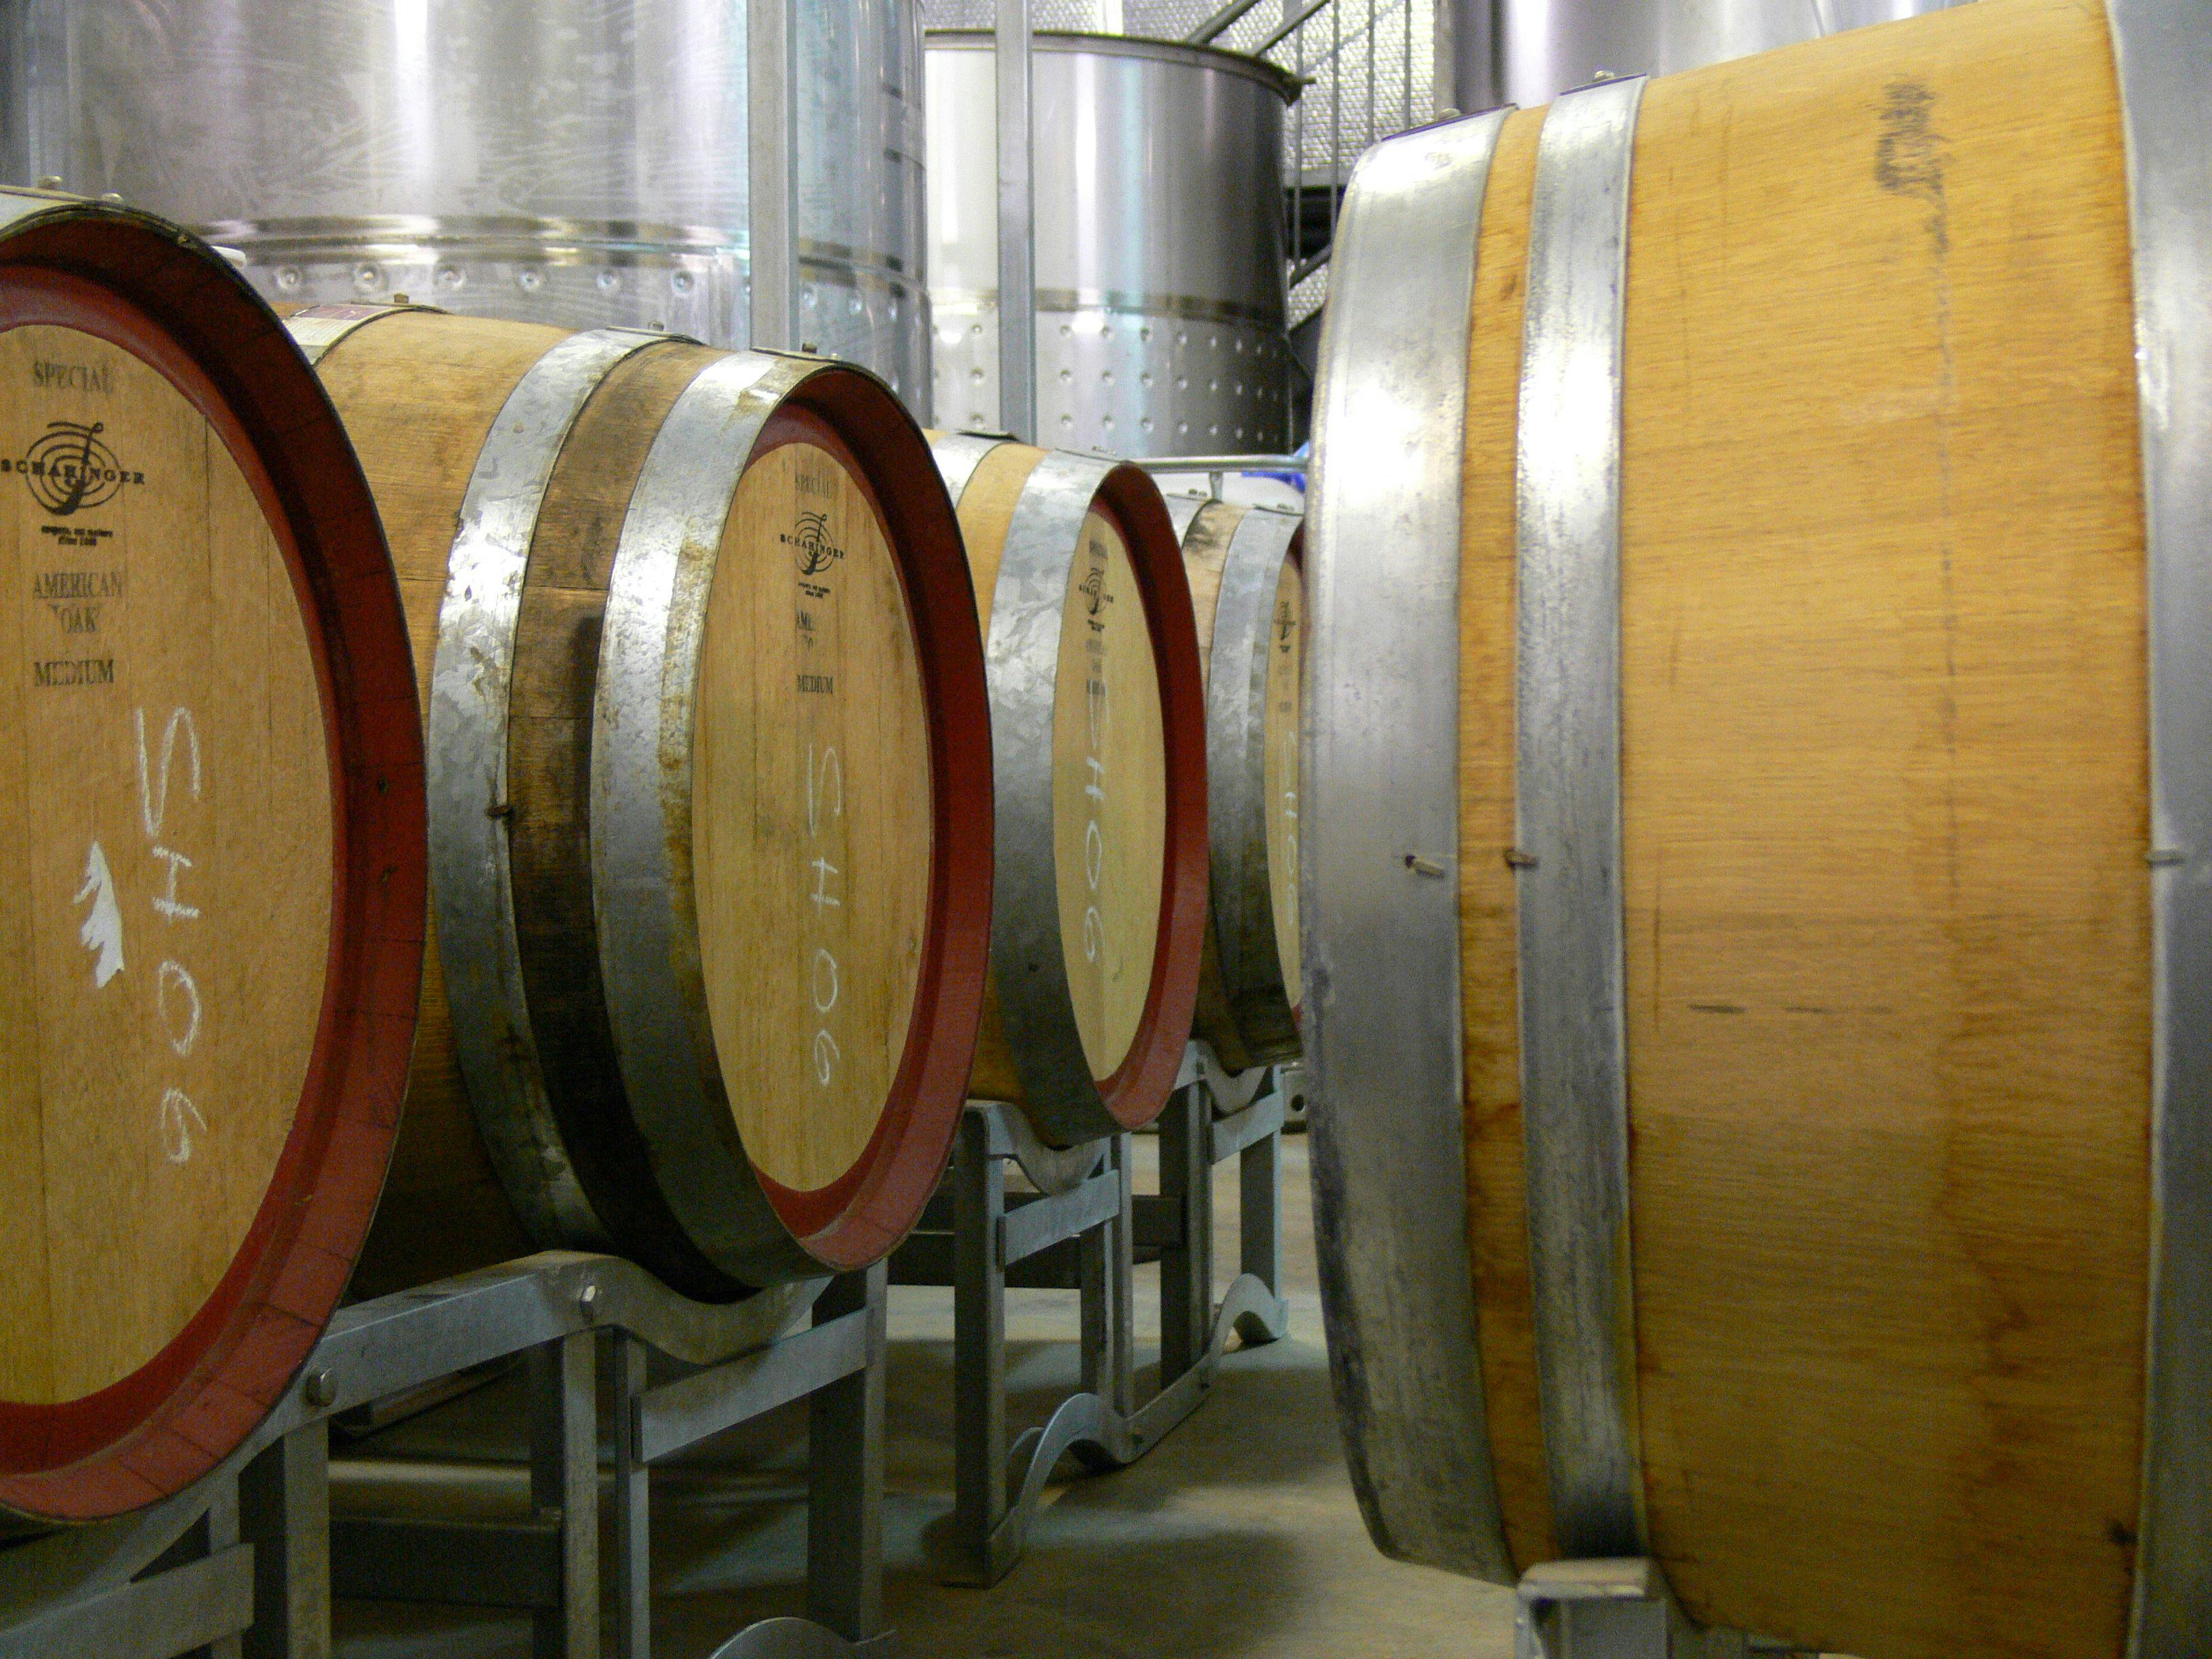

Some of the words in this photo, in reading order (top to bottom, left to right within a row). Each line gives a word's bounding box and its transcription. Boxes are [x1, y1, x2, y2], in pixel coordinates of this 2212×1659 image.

[33, 361, 112, 394] SPECIAL
[32, 571, 123, 600] AMERICAN
[57, 605, 98, 634] OAK
[33, 658, 114, 687] MEDIUM
